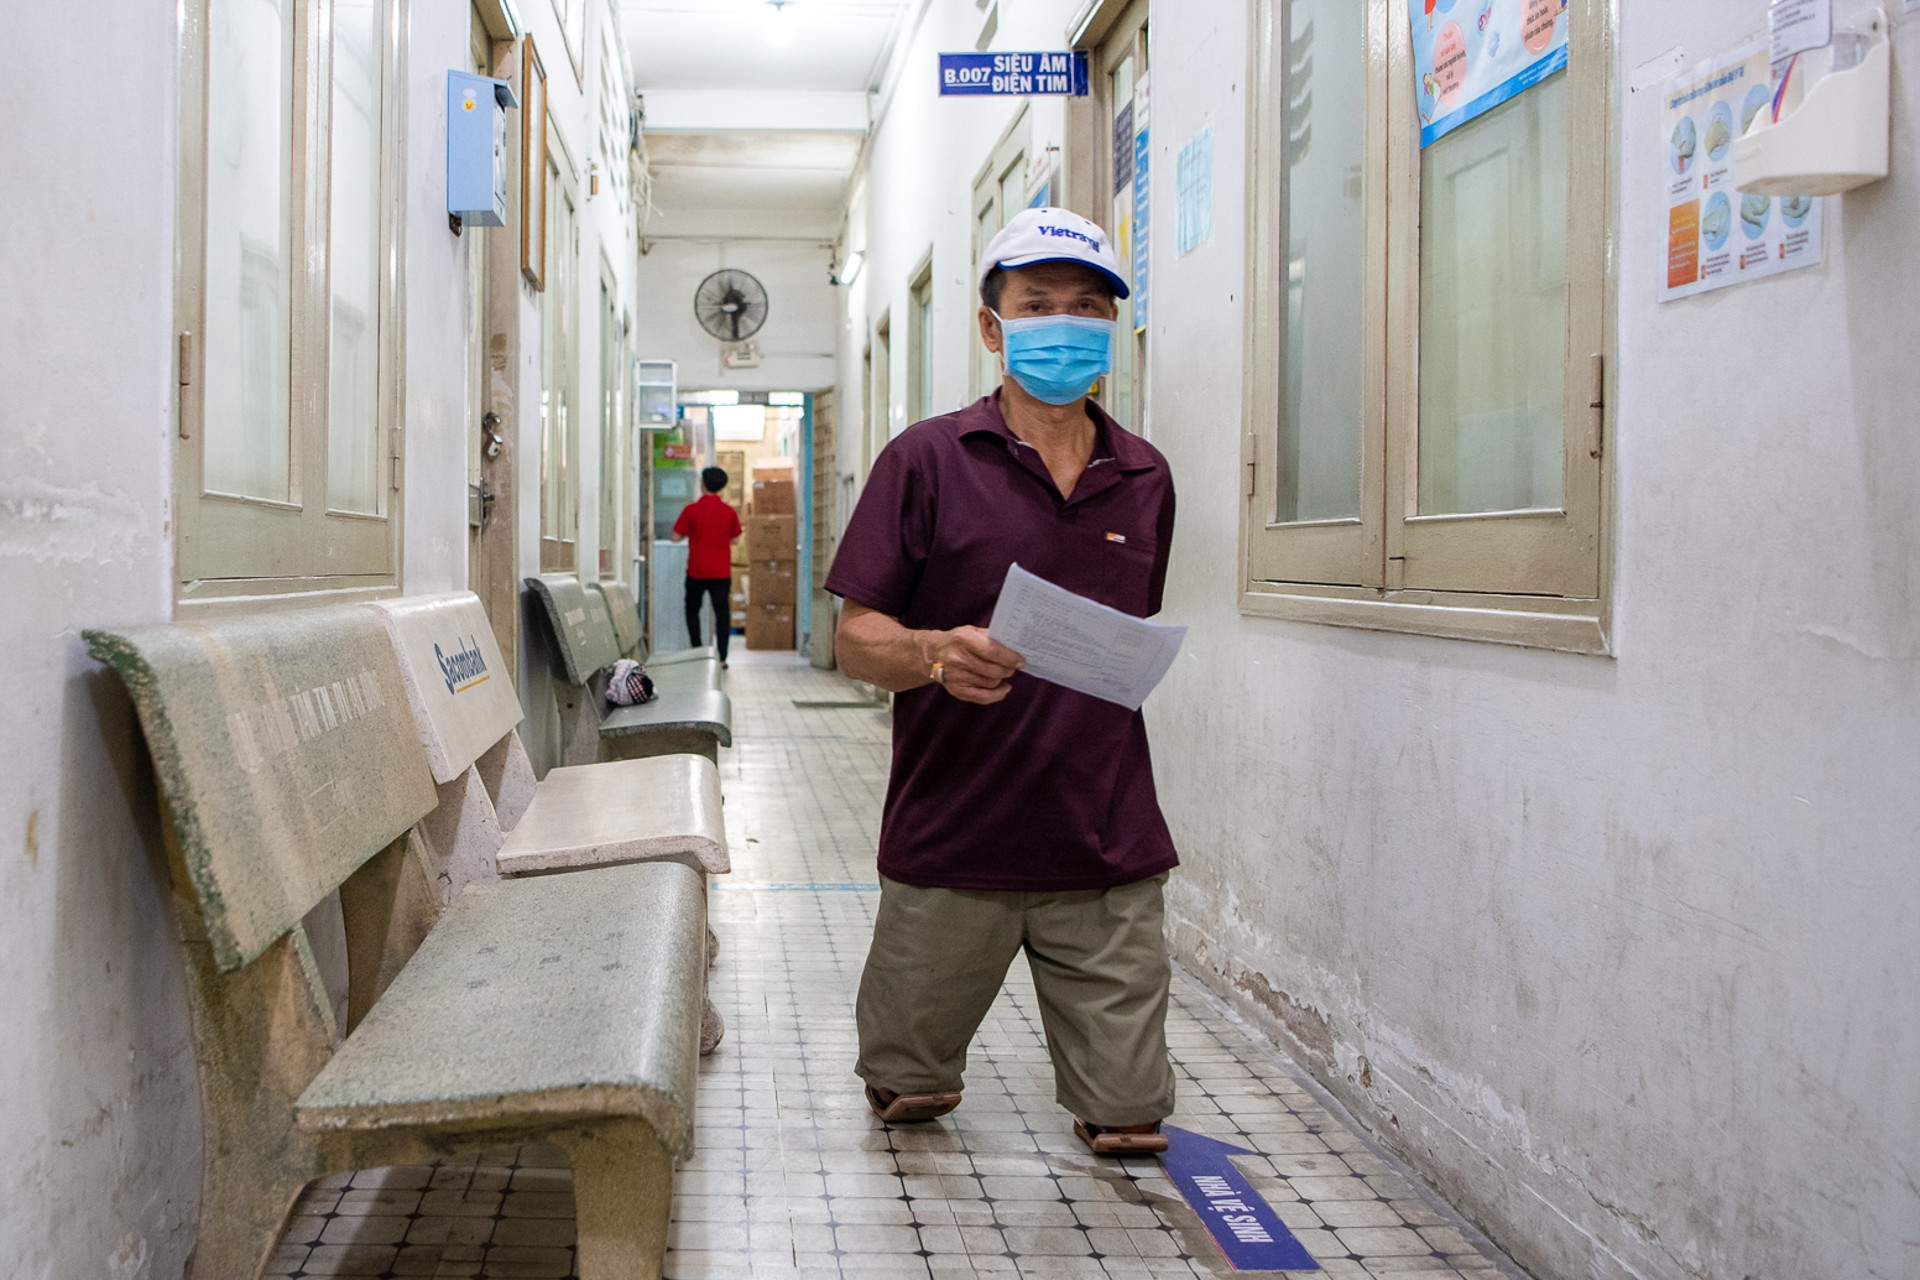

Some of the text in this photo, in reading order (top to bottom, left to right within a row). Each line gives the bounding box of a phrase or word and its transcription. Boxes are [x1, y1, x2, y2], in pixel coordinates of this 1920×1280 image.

[994, 53, 1067, 73] SIÊU ÂM
[944, 67, 991, 84] B.007
[992, 72, 1068, 95] ĐIỆN TIM
[434, 634, 487, 695] Sacombank
[1191, 1175, 1275, 1243] NHÀ VỆ SINH
